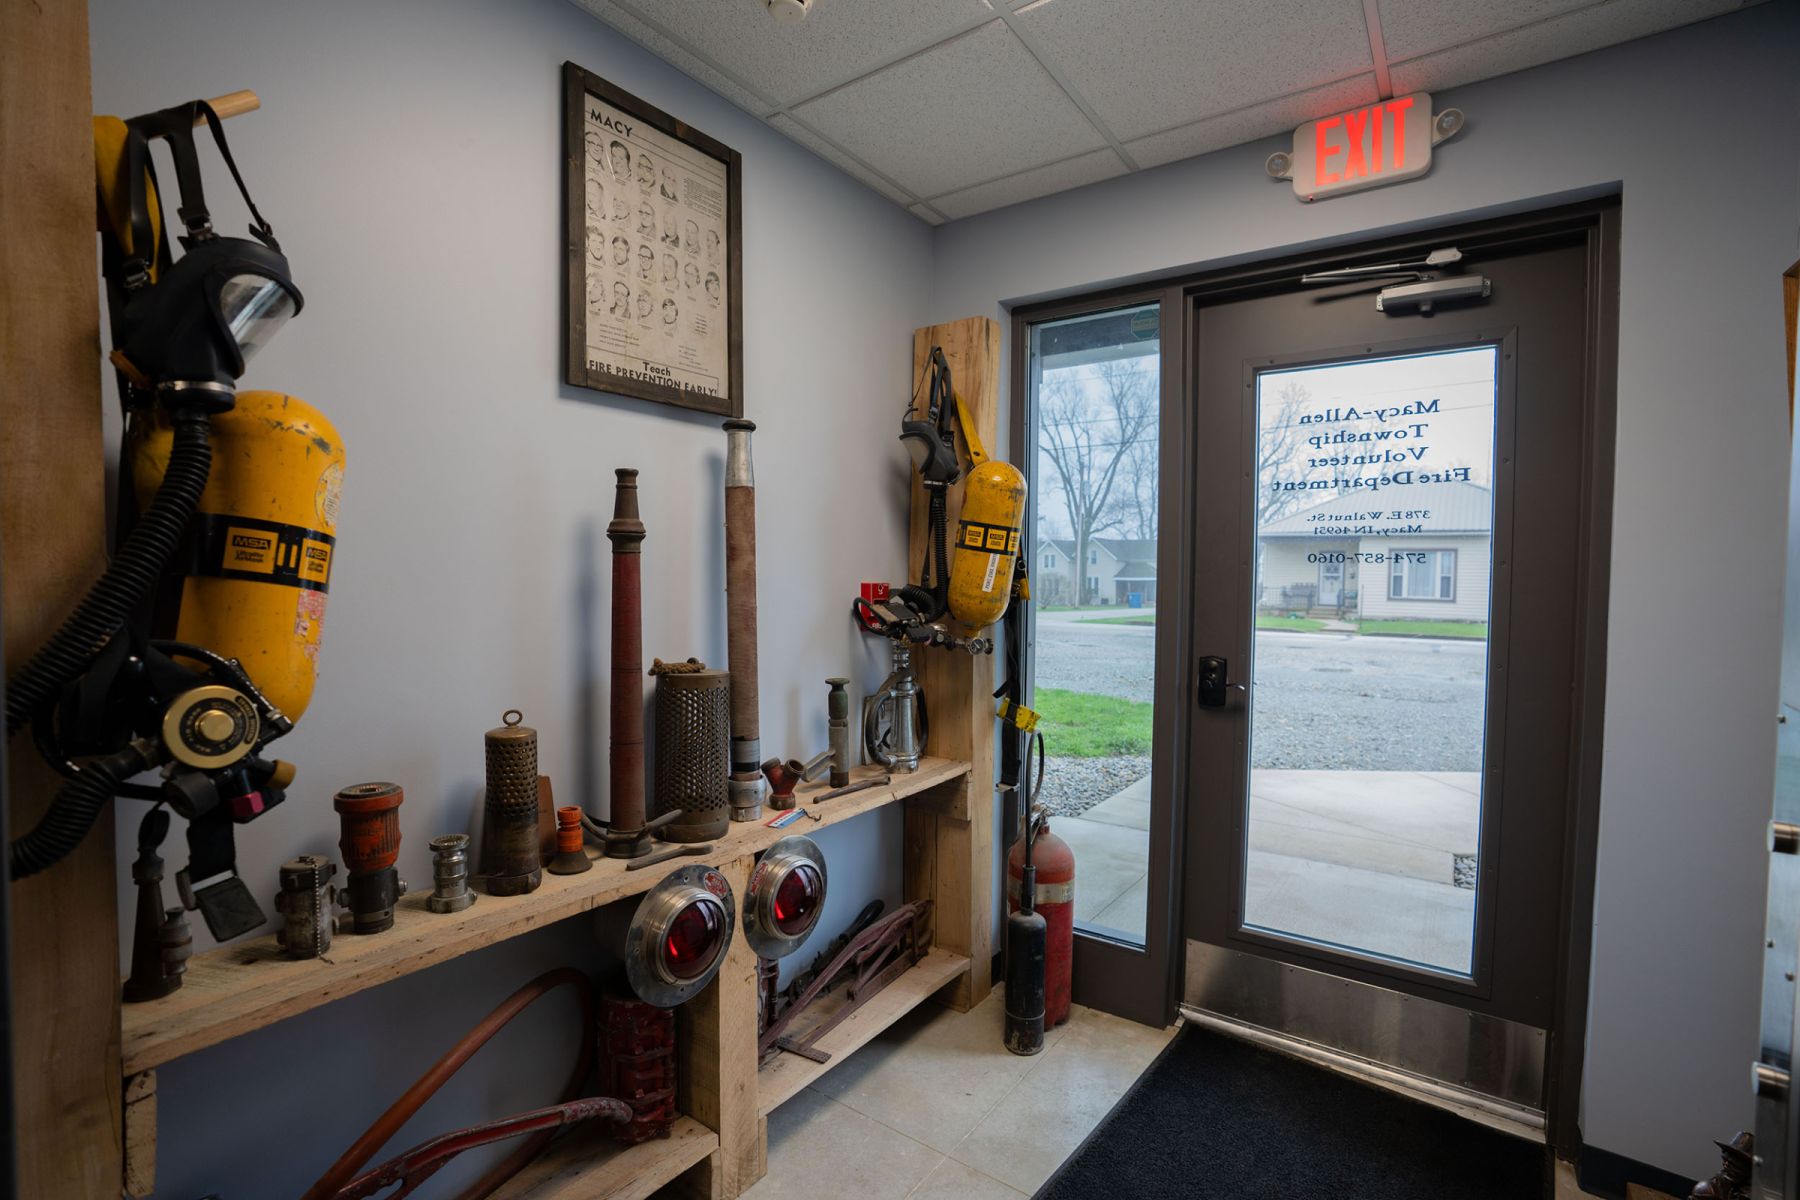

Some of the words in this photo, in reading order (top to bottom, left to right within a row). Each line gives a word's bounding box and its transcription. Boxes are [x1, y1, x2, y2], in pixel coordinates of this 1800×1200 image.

[590, 108, 632, 137] MACY
[1315, 97, 1414, 187] EXIT
[589, 359, 612, 375] FIRE
[615, 366, 681, 388] PREVENTION
[684, 382, 717, 397] EARLY!
[642, 361, 671, 377] Teach
[233, 538, 270, 549] MSA
